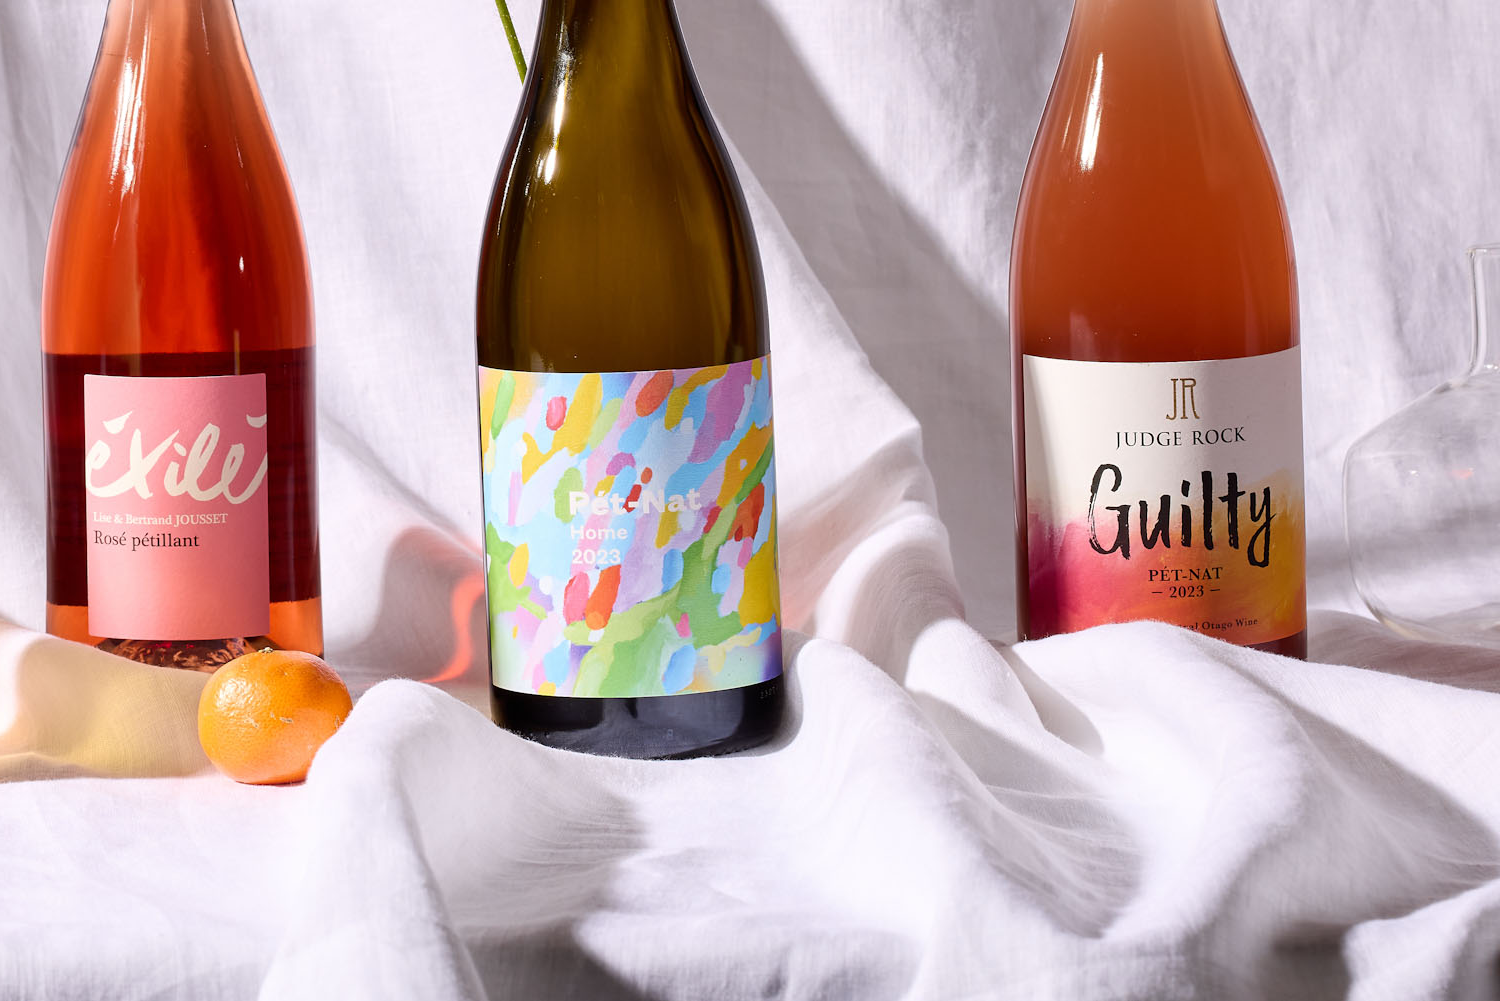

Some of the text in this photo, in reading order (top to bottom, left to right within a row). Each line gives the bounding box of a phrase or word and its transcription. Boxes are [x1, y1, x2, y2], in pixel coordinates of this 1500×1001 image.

[1166, 377, 1200, 421] JR
[1116, 426, 1246, 450] JUDGE ROCK
[568, 487, 702, 516] Pét-Nat
[93, 511, 228, 527] Lise & Bertrand JOUSSET
[1088, 463, 1276, 568] Guilty
[93, 530, 200, 551] Rosé pétillant
[570, 525, 628, 540] Home
[572, 548, 621, 565] 2023
[1149, 566, 1223, 582] PÉT-NAT
[1169, 586, 1205, 598] 2023
[1201, 621, 1233, 631] Otago
[1235, 618, 1258, 627] Wine
